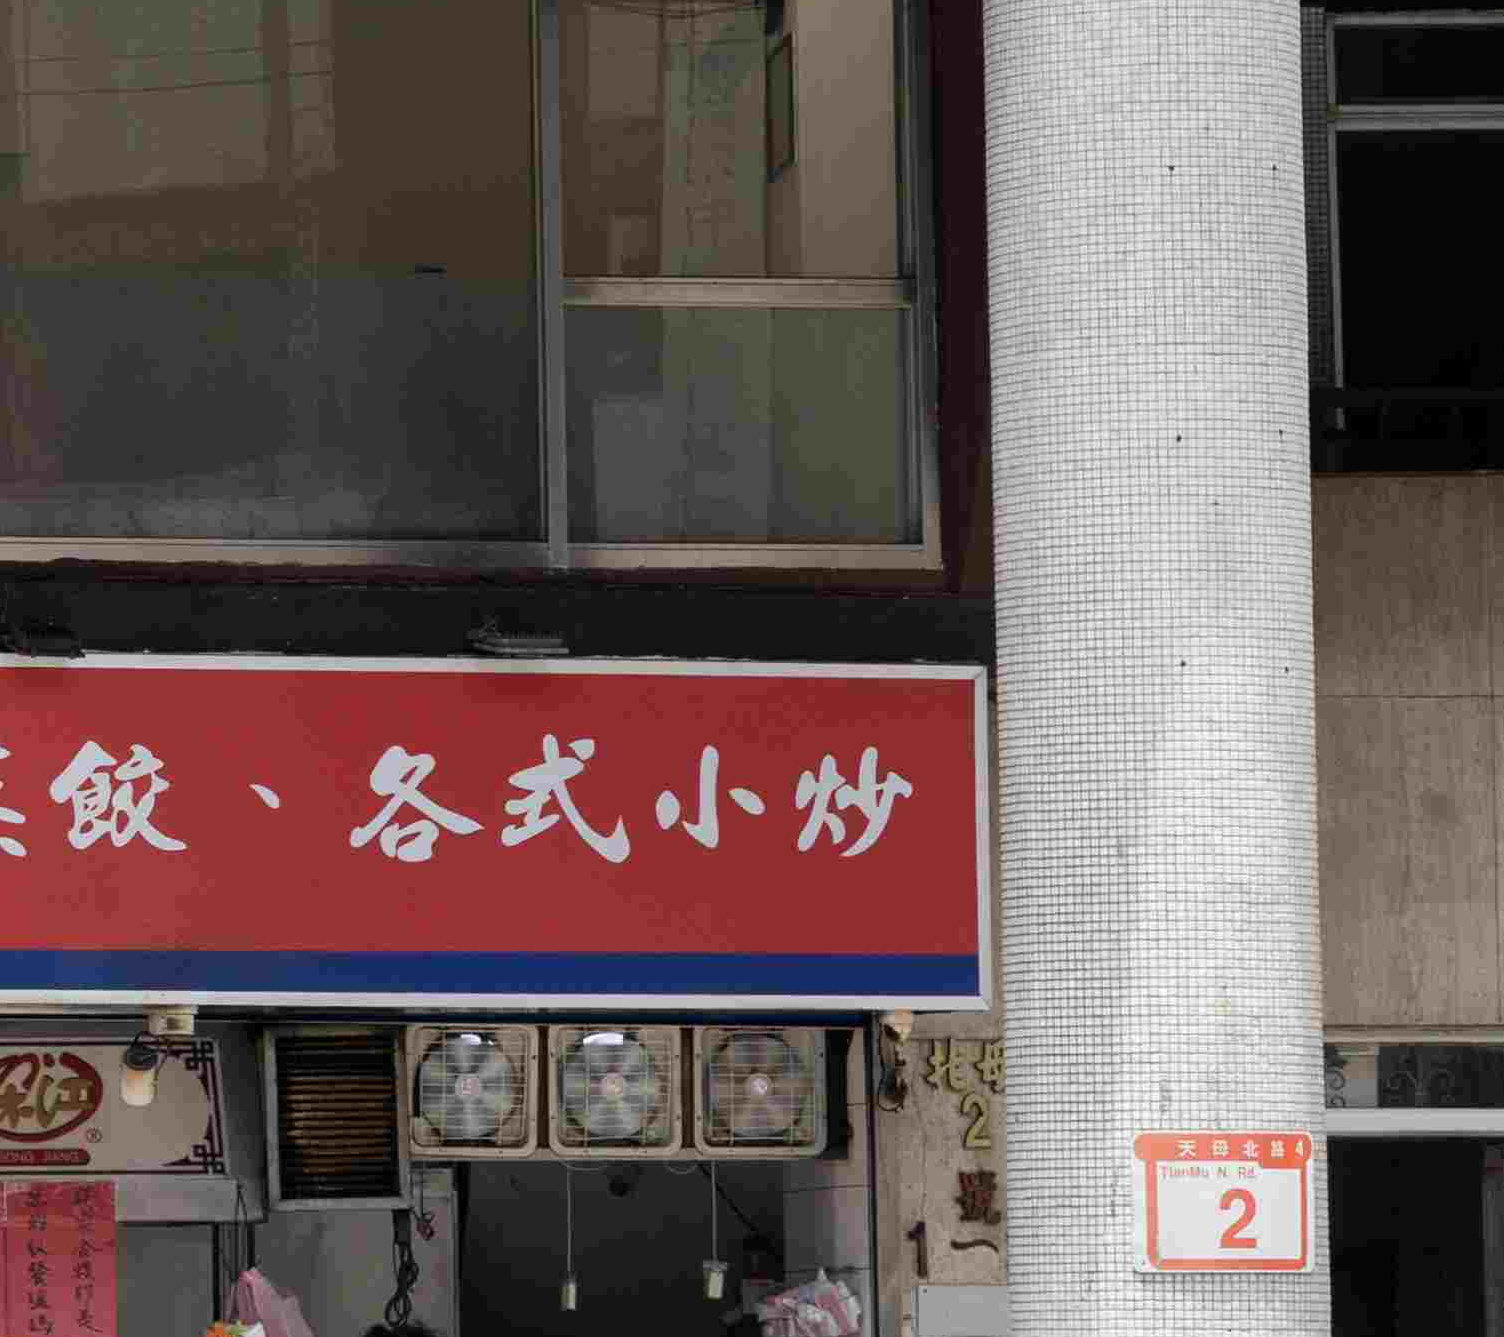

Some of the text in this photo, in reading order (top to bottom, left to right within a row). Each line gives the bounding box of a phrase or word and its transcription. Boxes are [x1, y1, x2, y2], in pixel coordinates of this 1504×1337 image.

[960, 1092, 993, 1150] 2
[1176, 1139, 1285, 1158] 天母北路
[955, 1169, 1002, 1226] 號
[1218, 1188, 1258, 1249] 2
